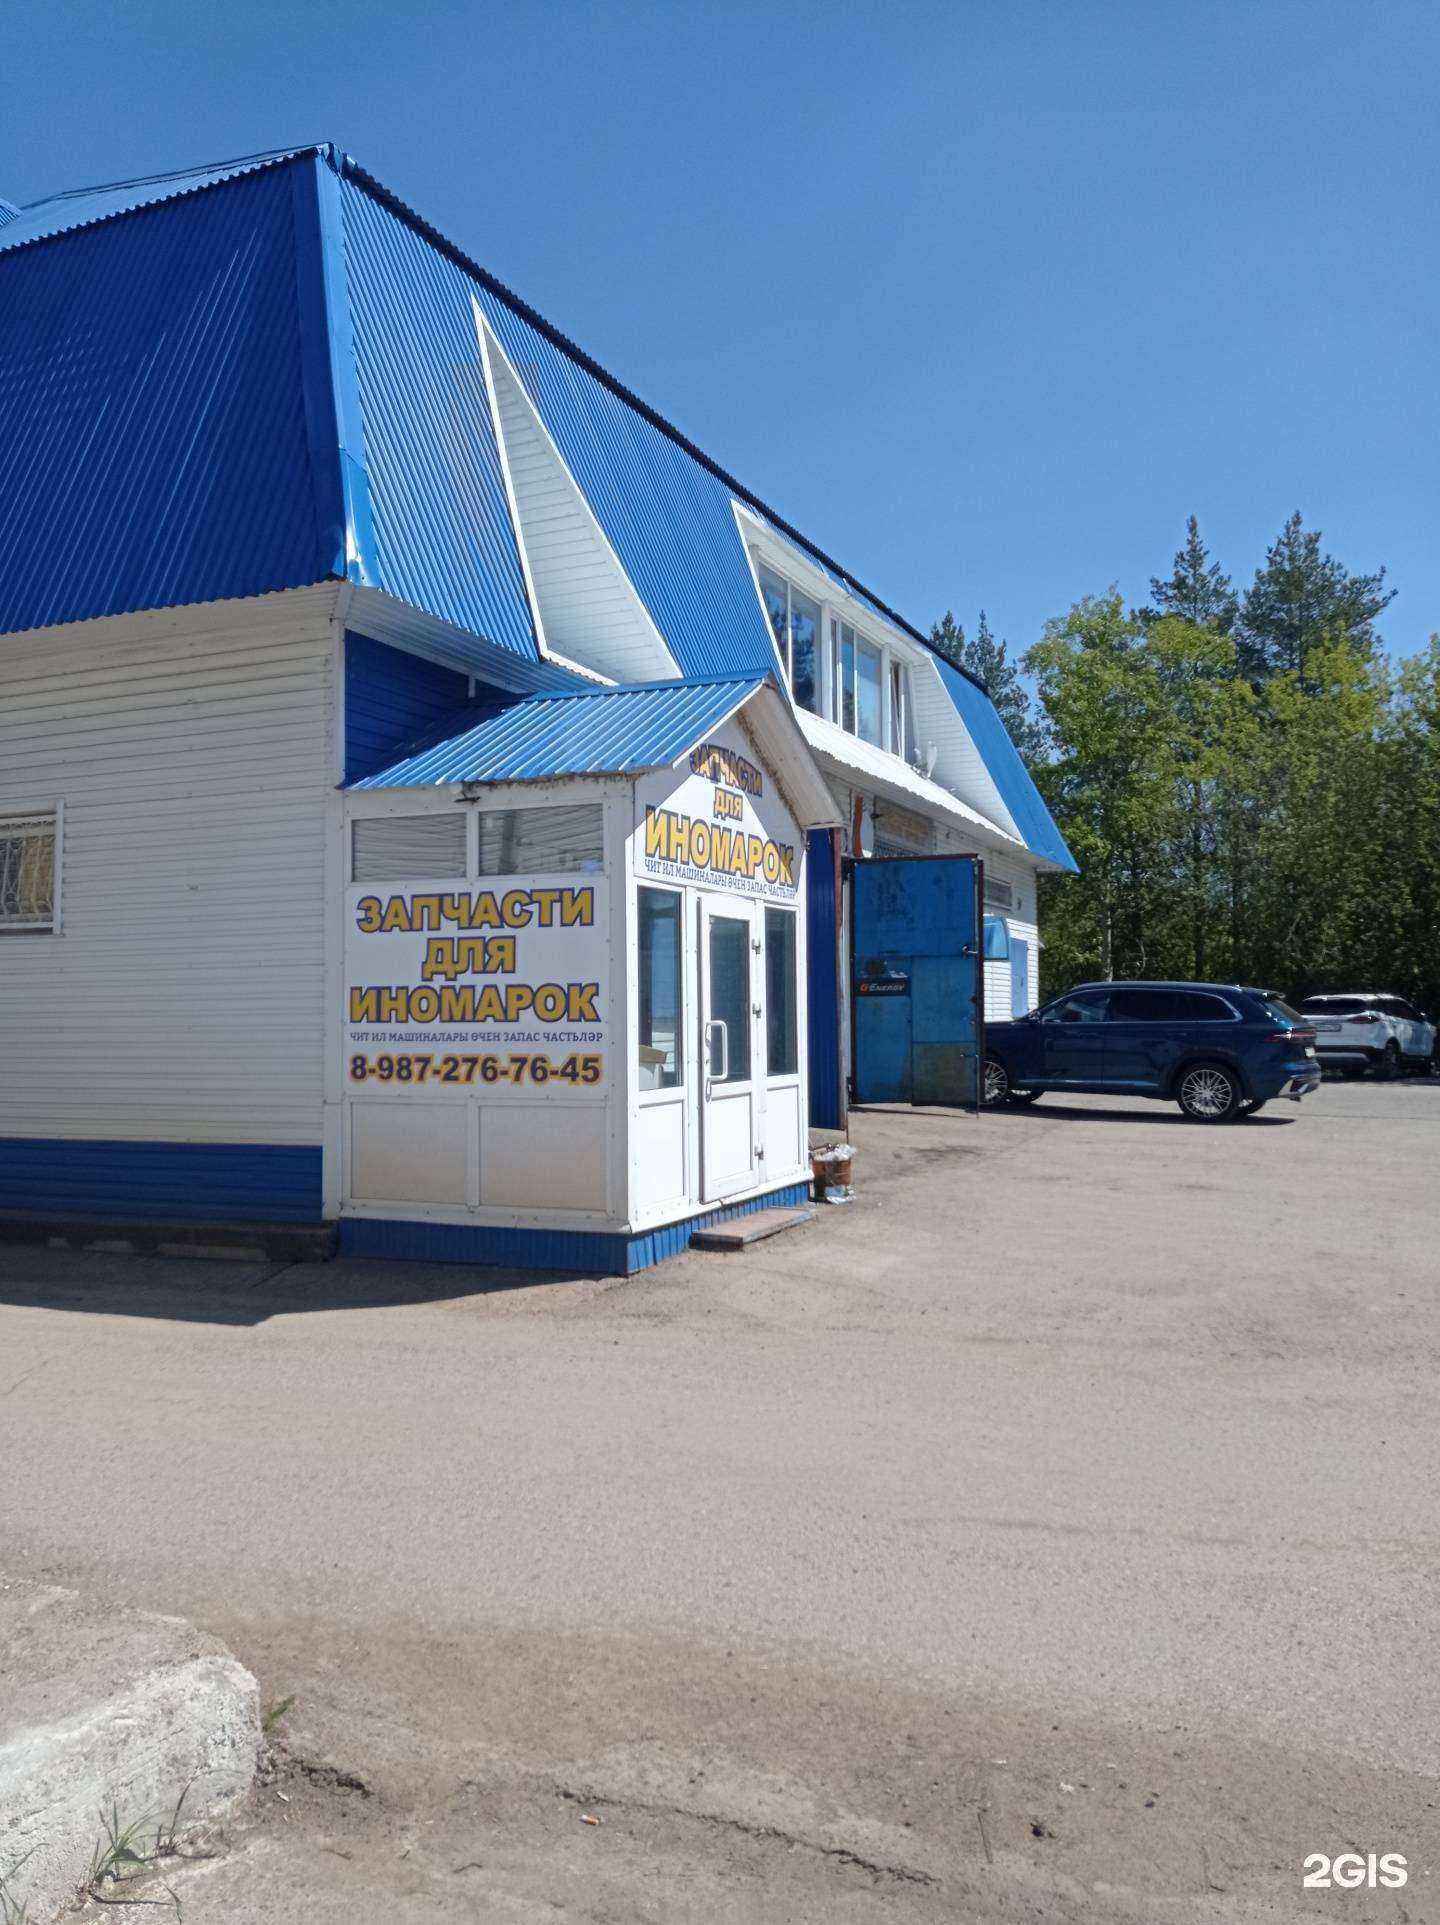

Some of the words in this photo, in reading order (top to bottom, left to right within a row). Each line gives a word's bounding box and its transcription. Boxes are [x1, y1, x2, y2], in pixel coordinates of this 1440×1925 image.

[689, 743, 763, 798] ЗАПЧАСТИ
[713, 786, 744, 822] ДЛЯ
[645, 804, 794, 887] ИНОМАРОК
[675, 865, 727, 887] МАШИНАЛАРЫ
[747, 880, 768, 895] ЗАПАС
[356, 887, 594, 932] ЗАПЧАСТИ
[421, 935, 516, 981] ДЛЯ
[350, 982, 601, 1023] ИНОМАРОК
[350, 1032, 370, 1042] ЧИТ
[371, 1032, 387, 1042] ИЛ
[388, 1032, 469, 1042] МАШИНАЛАРЫ
[471, 1032, 500, 1042] ӨЧЕН
[503, 1032, 540, 1042] ЗАПАС
[350, 1054, 602, 1084] 8-987-276-76-45
